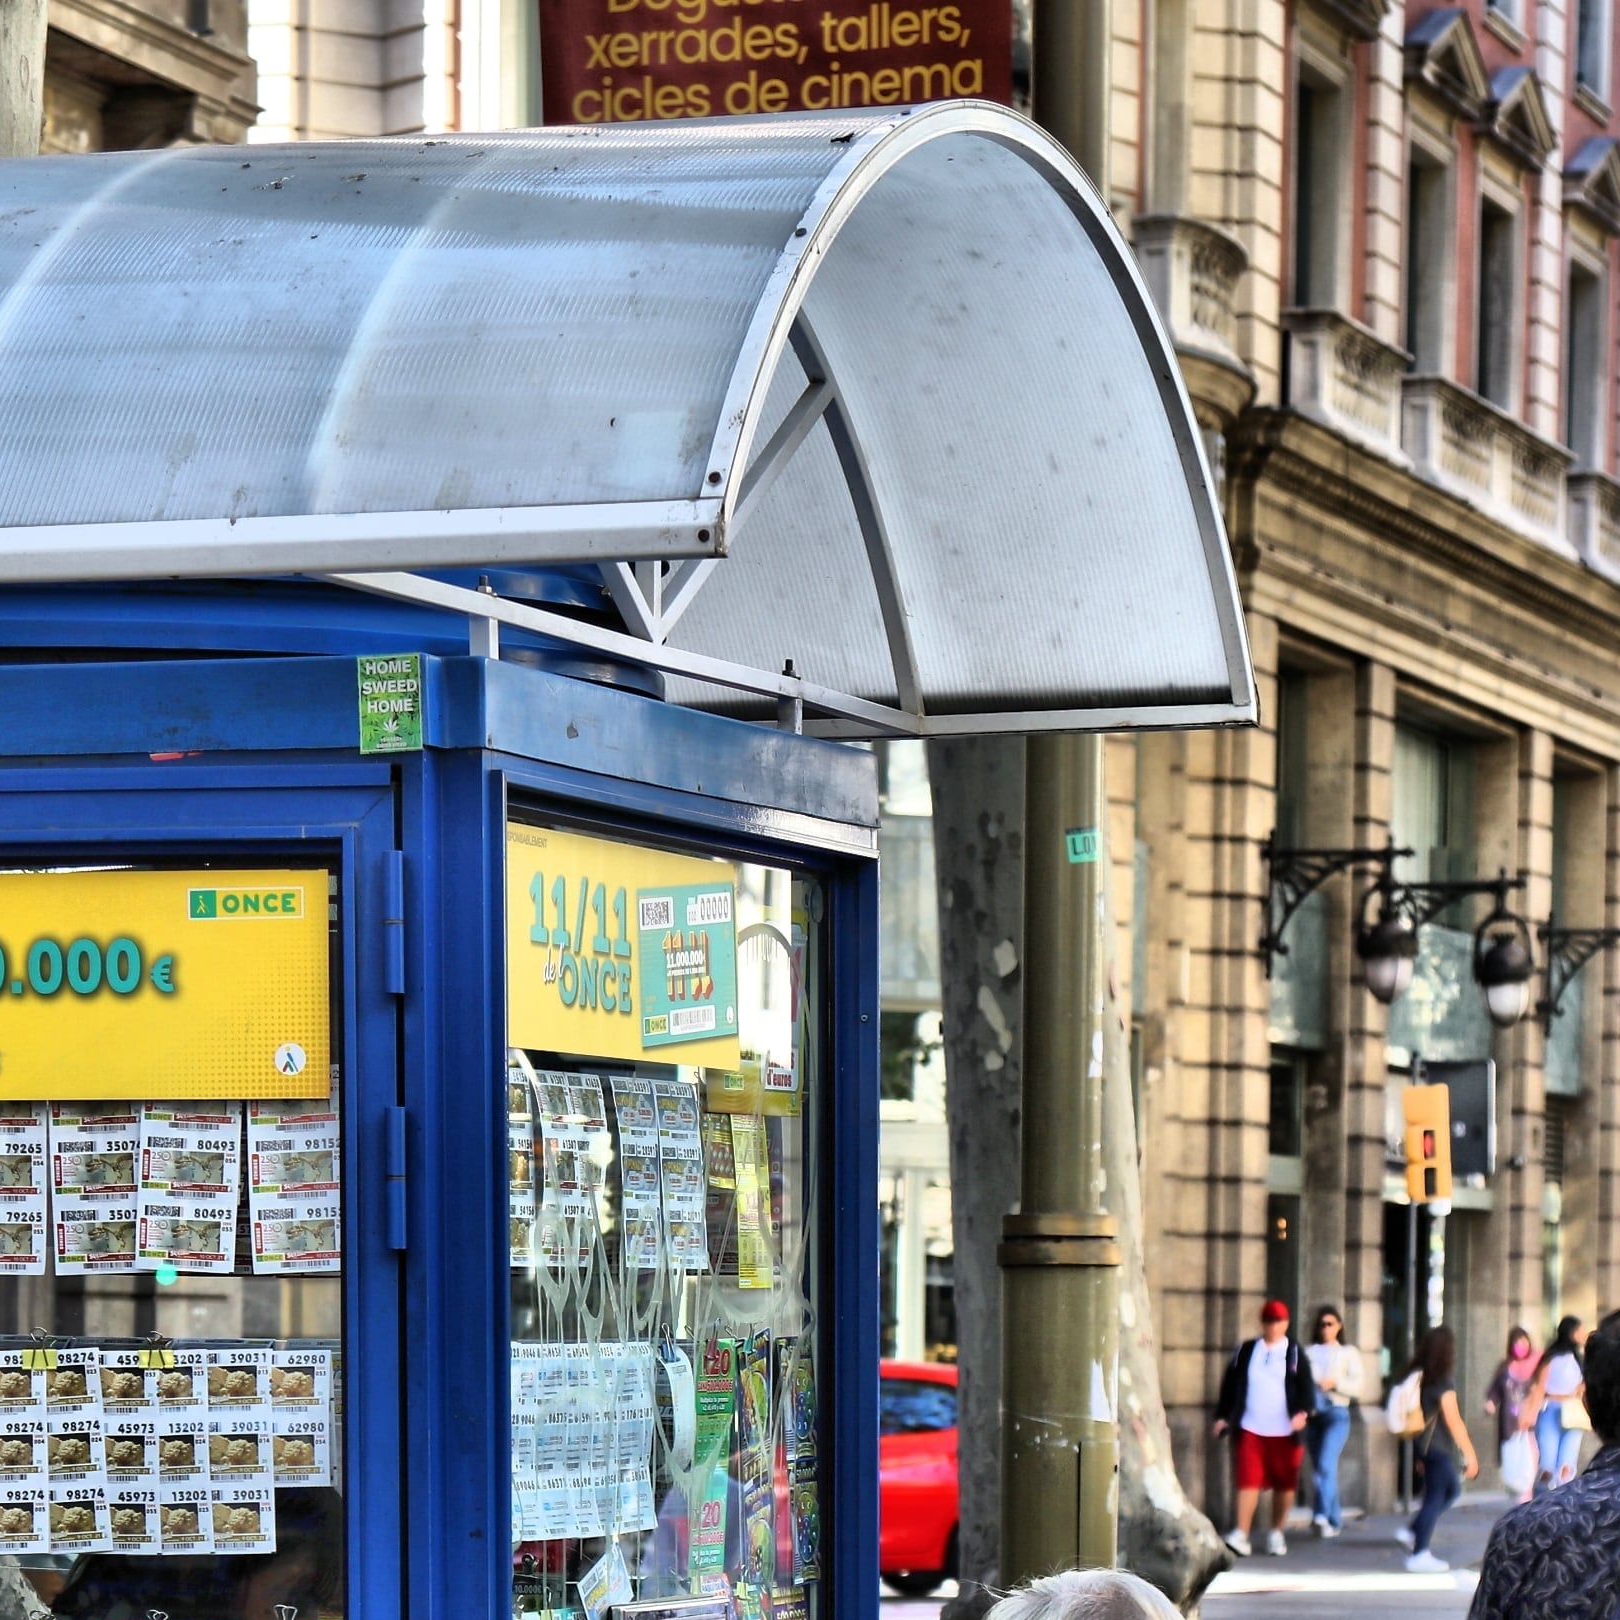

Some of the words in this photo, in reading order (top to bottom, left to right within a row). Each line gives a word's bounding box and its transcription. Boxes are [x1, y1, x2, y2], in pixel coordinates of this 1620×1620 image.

[585, 18, 808, 69] xerrades,
[822, 5, 971, 54] tallers,
[572, 76, 711, 123] cicles
[725, 71, 788, 114] de
[801, 57, 983, 109] cinema
[366, 660, 411, 675] HOME
[362, 679, 418, 695] SWEED
[367, 698, 414, 714] HOME
[222, 892, 297, 914] ONCE
[529, 871, 632, 957] 11/11
[4, 1142, 42, 1154] 79265
[197, 1140, 236, 1151] 80493
[5, 1211, 43, 1222] 79265
[194, 1208, 233, 1220] 80493
[57, 1352, 95, 1365] 98274
[230, 1352, 268, 1364] 39031
[287, 1353, 326, 1365] 62980
[5, 1422, 44, 1434] 98274
[62, 1420, 100, 1432] 98274
[117, 1422, 155, 1434] 45973
[168, 1421, 204, 1433] 13202
[231, 1420, 268, 1433] 39031
[287, 1422, 325, 1434] 62980
[66, 1488, 105, 1500] 98274
[117, 1490, 155, 1502] 45973
